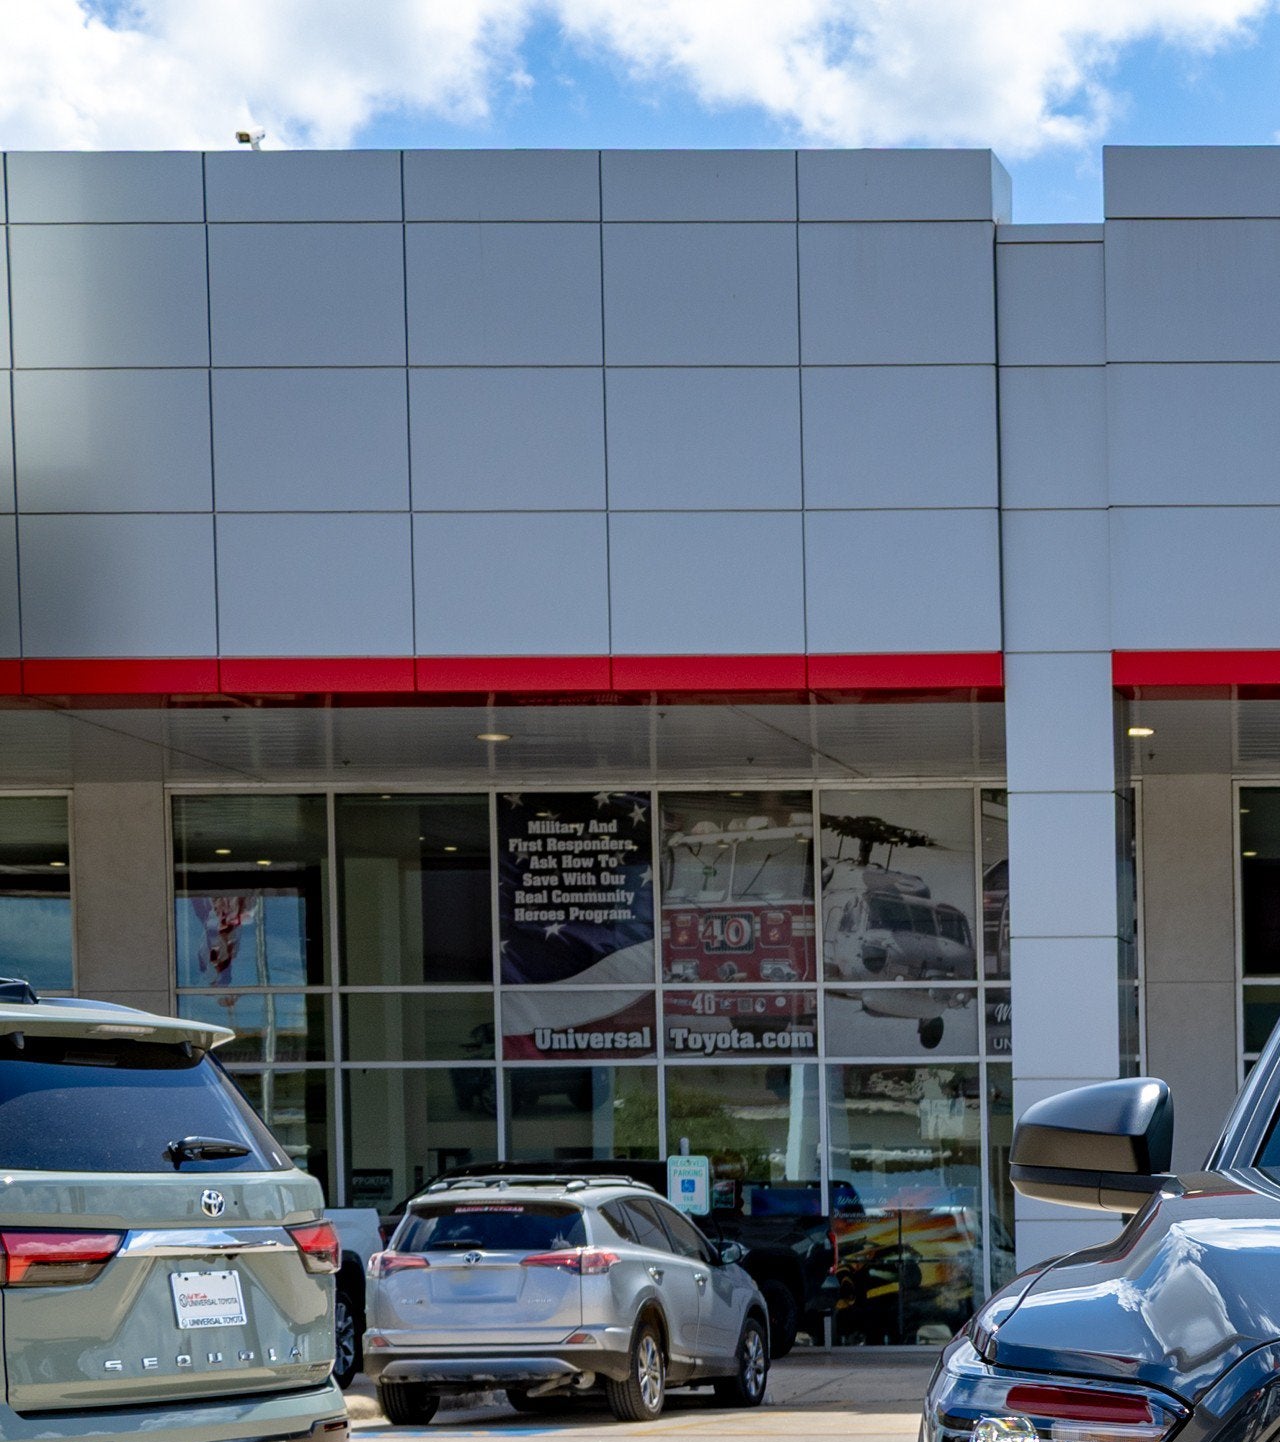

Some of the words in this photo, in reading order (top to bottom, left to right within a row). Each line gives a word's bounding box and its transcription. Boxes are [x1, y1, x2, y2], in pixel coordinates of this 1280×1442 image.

[527, 820, 585, 836] Military
[588, 819, 618, 833] And
[508, 838, 543, 852] First
[546, 837, 638, 854] Responders,
[529, 855, 558, 869] Ask
[561, 855, 594, 868] How
[597, 854, 618, 868] To
[522, 872, 559, 887] Save
[562, 871, 596, 886] With
[600, 871, 626, 885] Our
[515, 890, 548, 904] Real
[551, 889, 635, 905] Community
[514, 907, 566, 921] Heroes
[569, 907, 636, 924] Program.
[700, 917, 751, 948] 40
[691, 993, 716, 1015] 40
[534, 1027, 652, 1050] Universal
[669, 1028, 814, 1055] Toyota.com
[672, 1168, 704, 1178] PARKING
[188, 1299, 218, 1307] UNIVERSAL
[218, 1297, 238, 1306] TOYOTA
[188, 1317, 222, 1326] UNIVERSAL
[222, 1315, 245, 1324] TOYOTA
[104, 1345, 302, 1372] SEQUOIA
